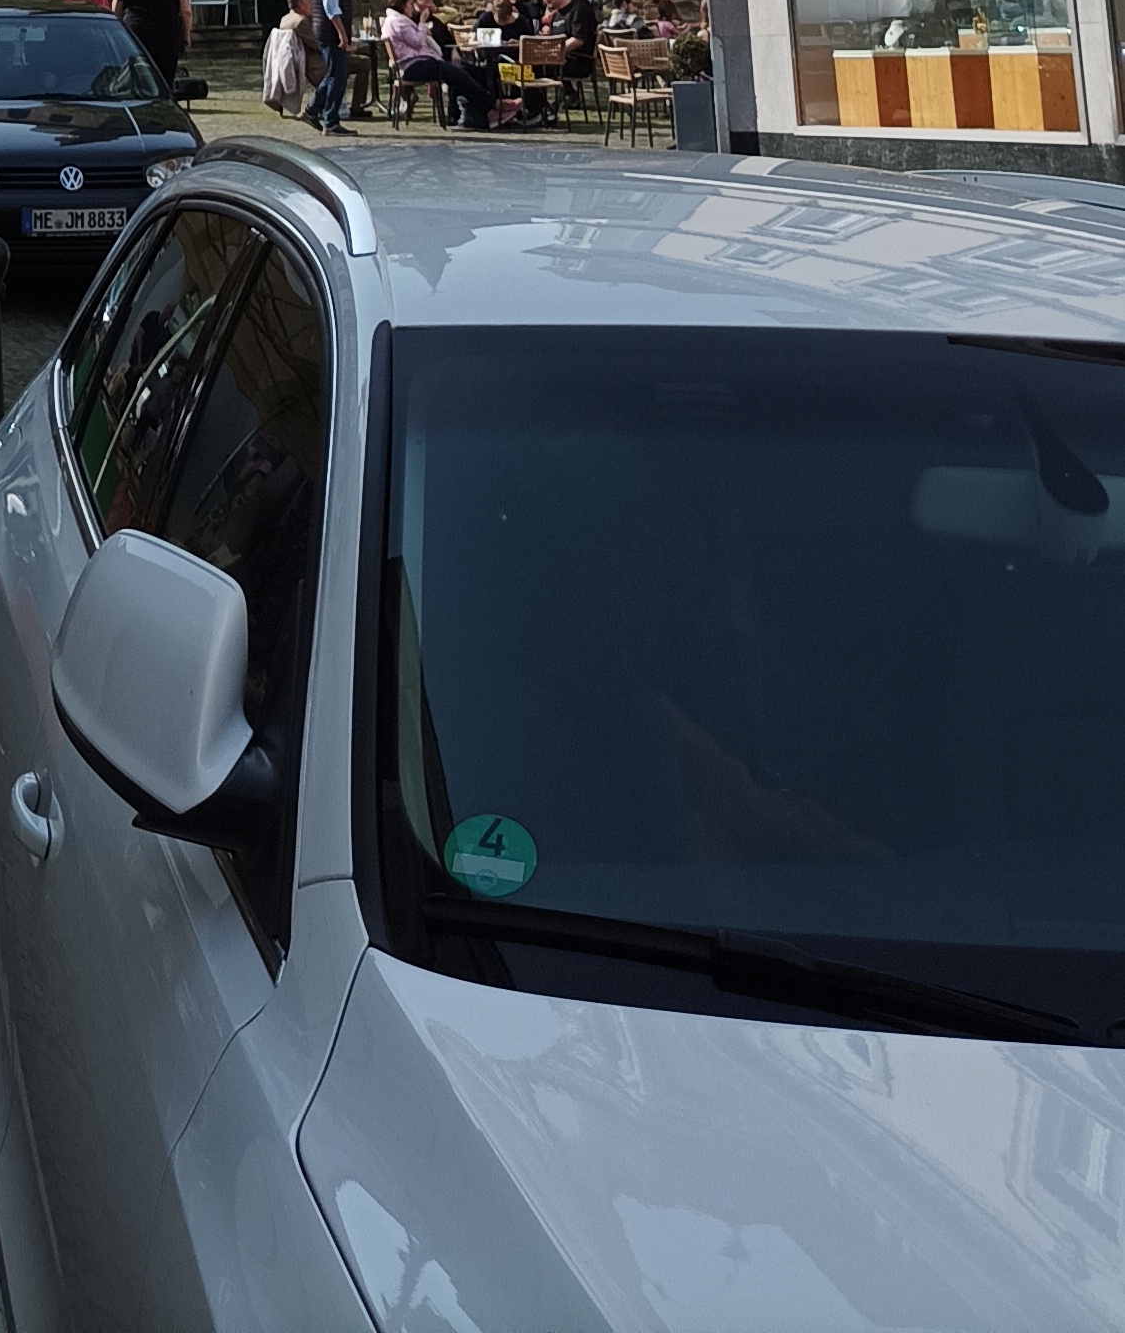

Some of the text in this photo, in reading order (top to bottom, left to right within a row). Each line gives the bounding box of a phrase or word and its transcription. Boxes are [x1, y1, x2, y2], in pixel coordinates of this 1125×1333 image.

[33, 211, 125, 229] ME JM 8833
[478, 817, 505, 857] 4
